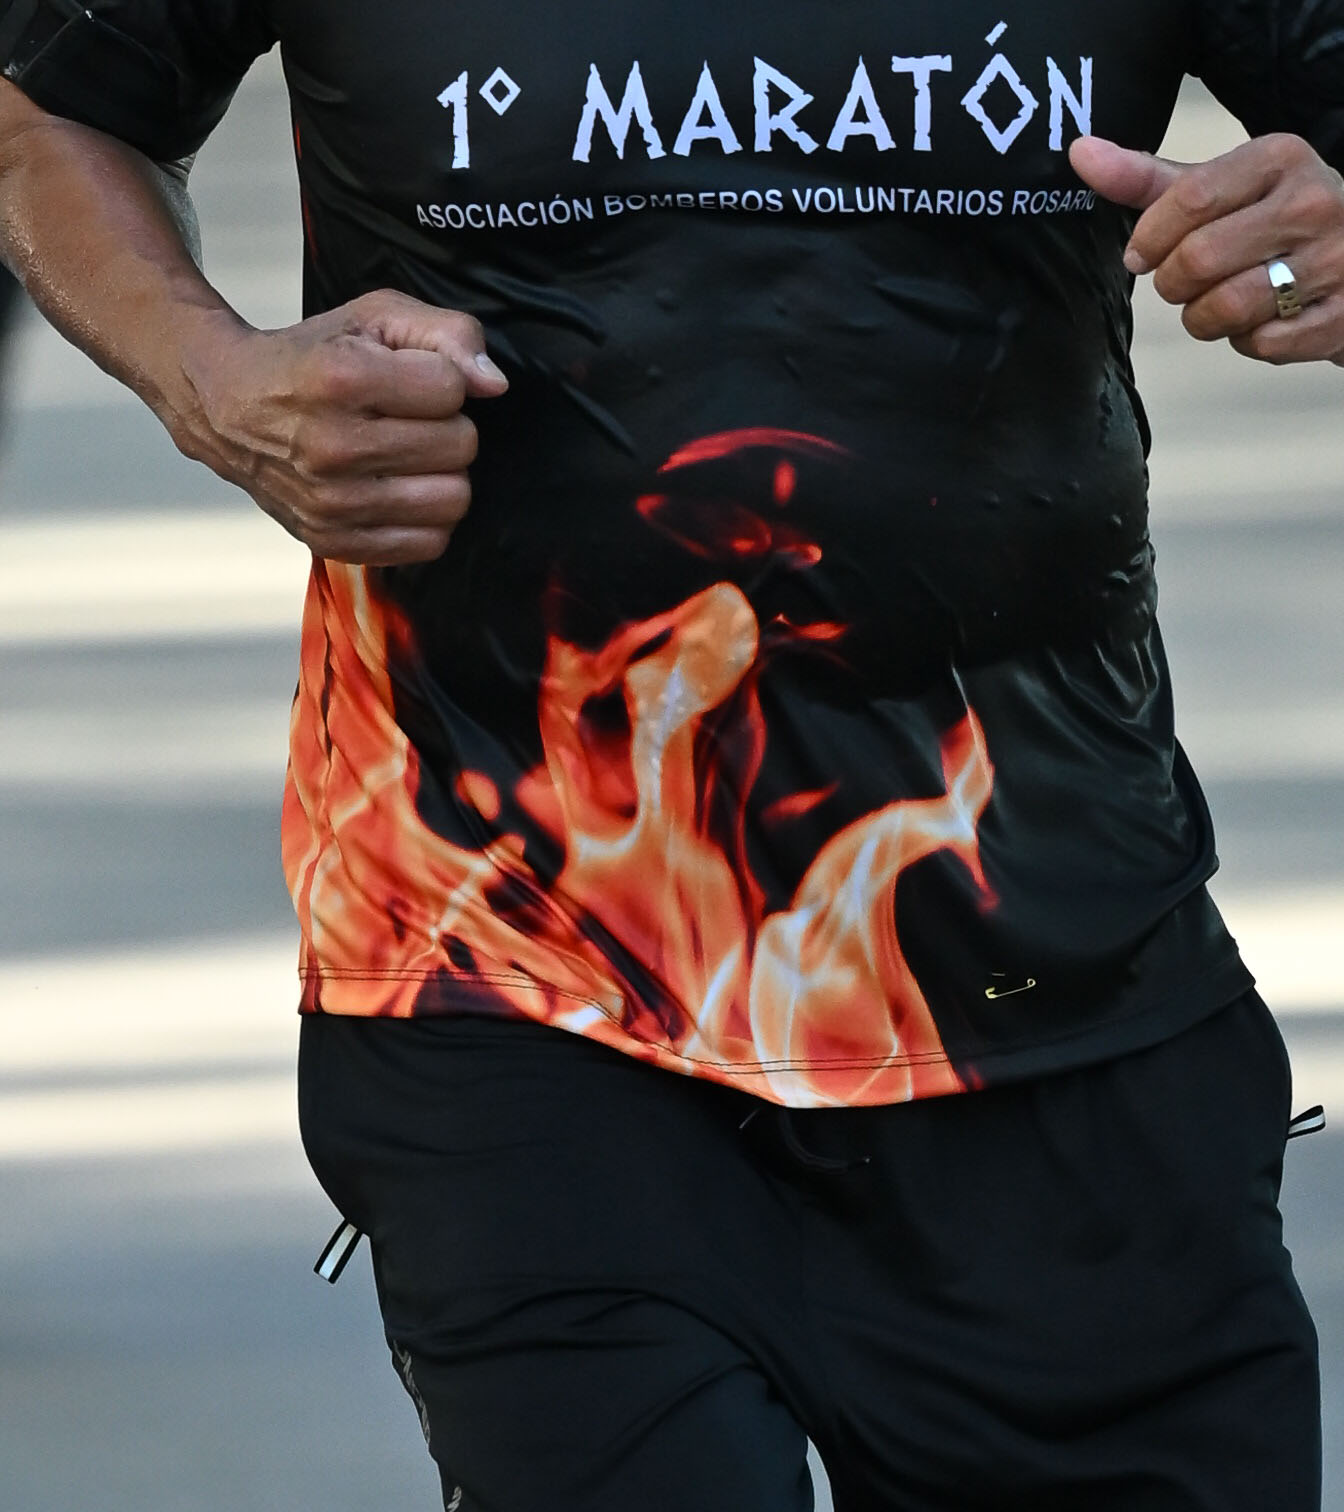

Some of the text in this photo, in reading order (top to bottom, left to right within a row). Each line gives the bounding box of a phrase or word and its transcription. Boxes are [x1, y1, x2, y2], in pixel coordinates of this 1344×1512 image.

[571, 20, 1093, 164] MARATÓN
[416, 193, 594, 229] ASOCIACIÓN
[603, 188, 784, 217] BOMBEROS
[791, 186, 1005, 216] VOLUNTARIOS
